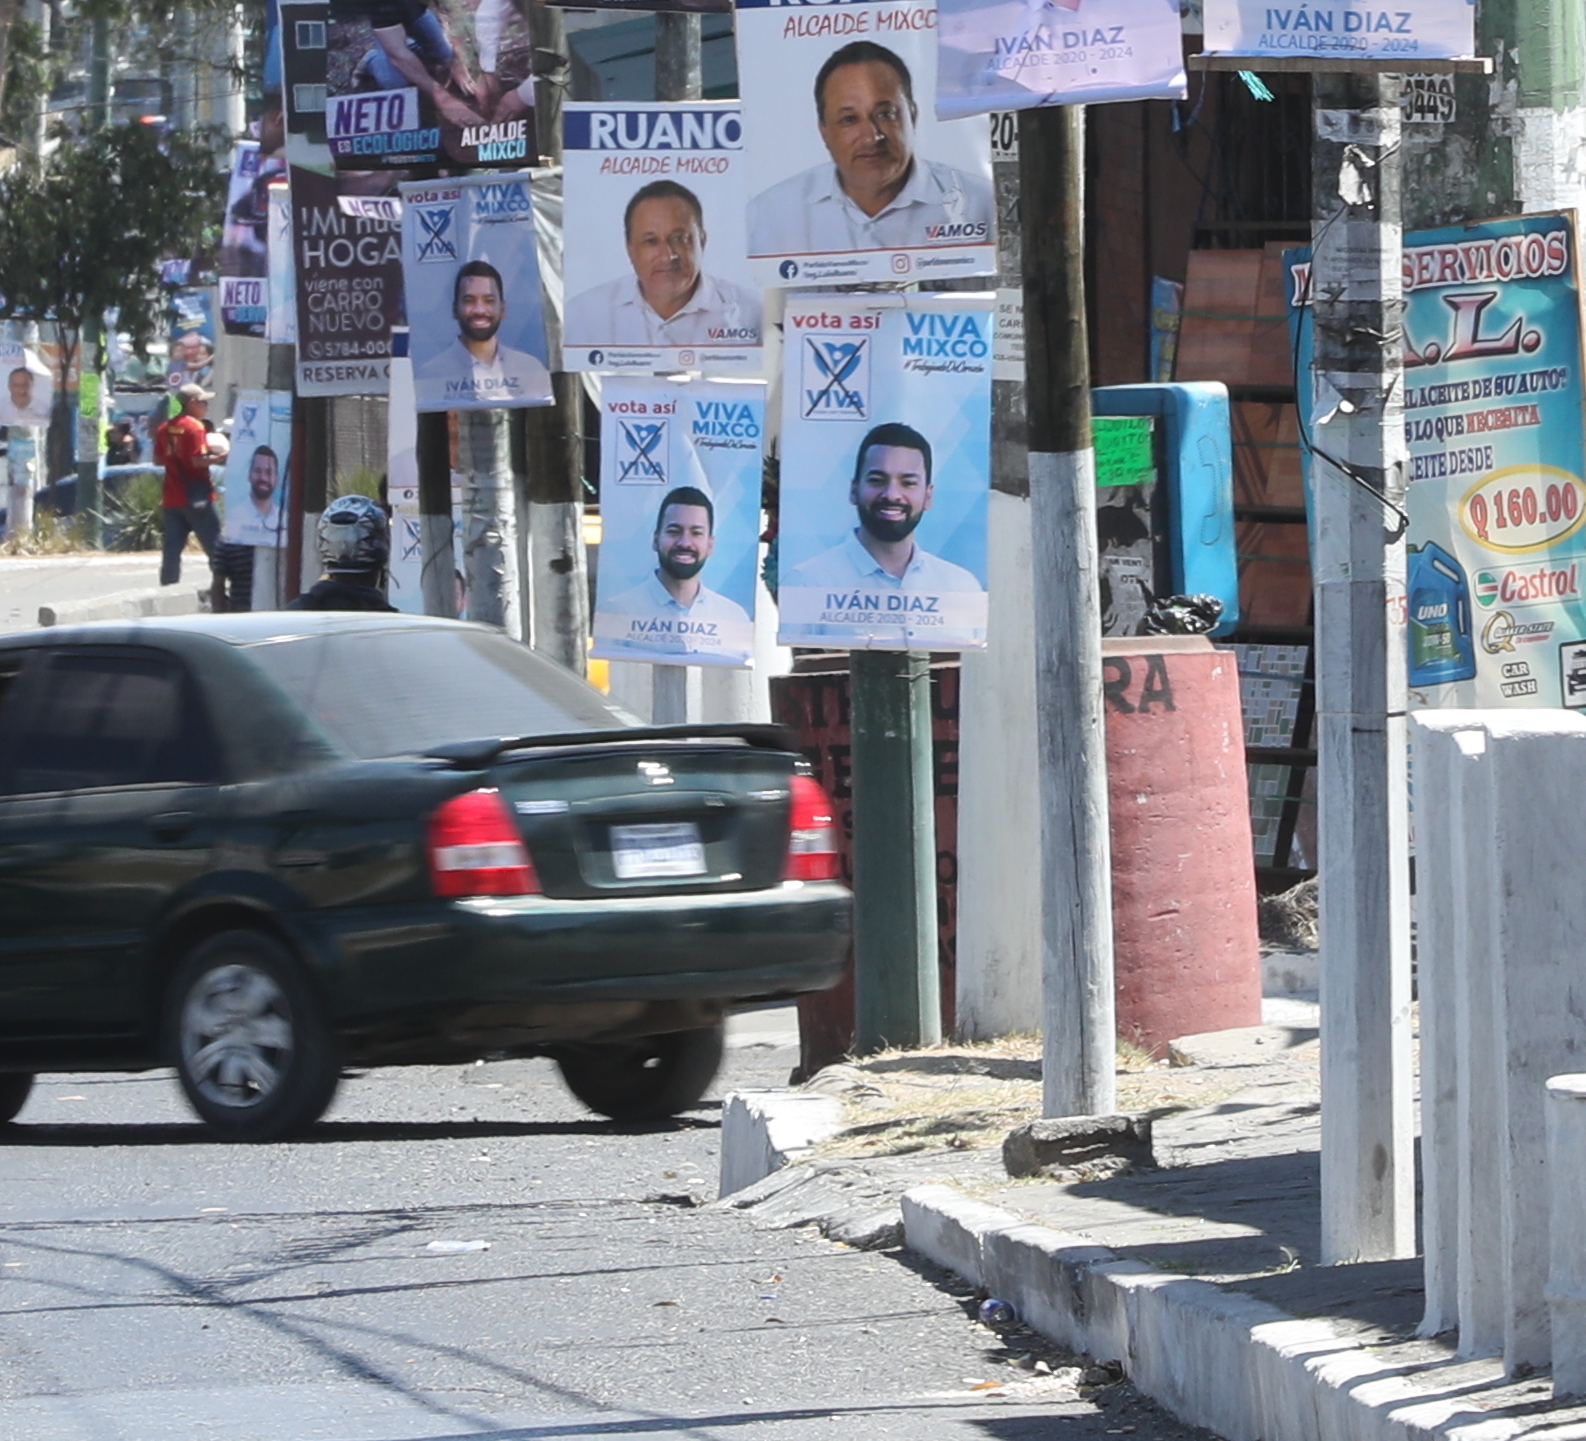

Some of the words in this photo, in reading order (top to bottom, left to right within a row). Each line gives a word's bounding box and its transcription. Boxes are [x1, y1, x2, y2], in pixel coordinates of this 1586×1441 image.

[783, 10, 870, 39] ALCALDE
[1266, 5, 1335, 33] IVÁN
[1342, 11, 1414, 35] DIAZ
[994, 25, 1055, 55] IVÁN
[1061, 25, 1127, 49] DIAZ
[1258, 35, 1329, 50] ALCALDE
[1382, 38, 1420, 52] 2024
[986, 52, 1049, 72] ALCALDE
[1052, 49, 1088, 65] 2020
[1098, 46, 1134, 62] 2024
[334, 93, 406, 136] NETO
[461, 120, 528, 147] ALCALDE
[590, 113, 743, 150] RUANO
[338, 139, 352, 153] ES
[478, 138, 527, 162] MIXCO
[599, 156, 670, 176] ALCALDE
[675, 155, 729, 175] MIXCO
[406, 190, 439, 204] vota
[478, 183, 524, 200] VIVA
[475, 199, 530, 213] MIXCO
[925, 223, 988, 240] VAMOS
[417, 241, 456, 256] VIVA
[305, 273, 348, 292] viene
[352, 275, 383, 290] con
[224, 280, 261, 307] NETO
[308, 290, 382, 312] CARRO
[308, 312, 384, 333] NUEVO
[792, 312, 842, 330] vota
[849, 311, 883, 330] así
[905, 312, 982, 339] VIVA
[707, 328, 759, 340] VAMOS
[902, 337, 988, 358] MIXCO
[302, 363, 378, 383] RESERVA
[446, 377, 482, 392] IVÁN
[484, 376, 520, 390] DIAZ
[1419, 381, 1470, 406] ACEITE
[1472, 380, 1492, 399] DE
[1495, 375, 1516, 397] SU
[608, 400, 649, 415] vota
[653, 399, 677, 415] así
[805, 389, 865, 409] VIVA
[696, 401, 755, 423] VIVA
[692, 420, 760, 439] MIXCO
[1413, 423, 1434, 442] LO
[1435, 420, 1464, 444] QUE
[1465, 404, 1541, 434] NECESITA
[619, 460, 665, 477] VIVA
[1449, 446, 1493, 476] DESDE
[1470, 493, 1489, 542] Q
[1493, 481, 1578, 529] 160.00
[1500, 563, 1578, 602] Castrol
[825, 590, 883, 611] IVÁN
[886, 592, 939, 613] DIAZ
[819, 610, 875, 624] ALCALDE
[877, 611, 907, 625] 2020
[916, 613, 945, 626] 2024
[1417, 603, 1448, 621] UNO
[631, 618, 675, 634] IVÁN
[677, 621, 718, 637] DIAZ
[1502, 663, 1530, 678] CAR
[1501, 680, 1537, 697] WASH
